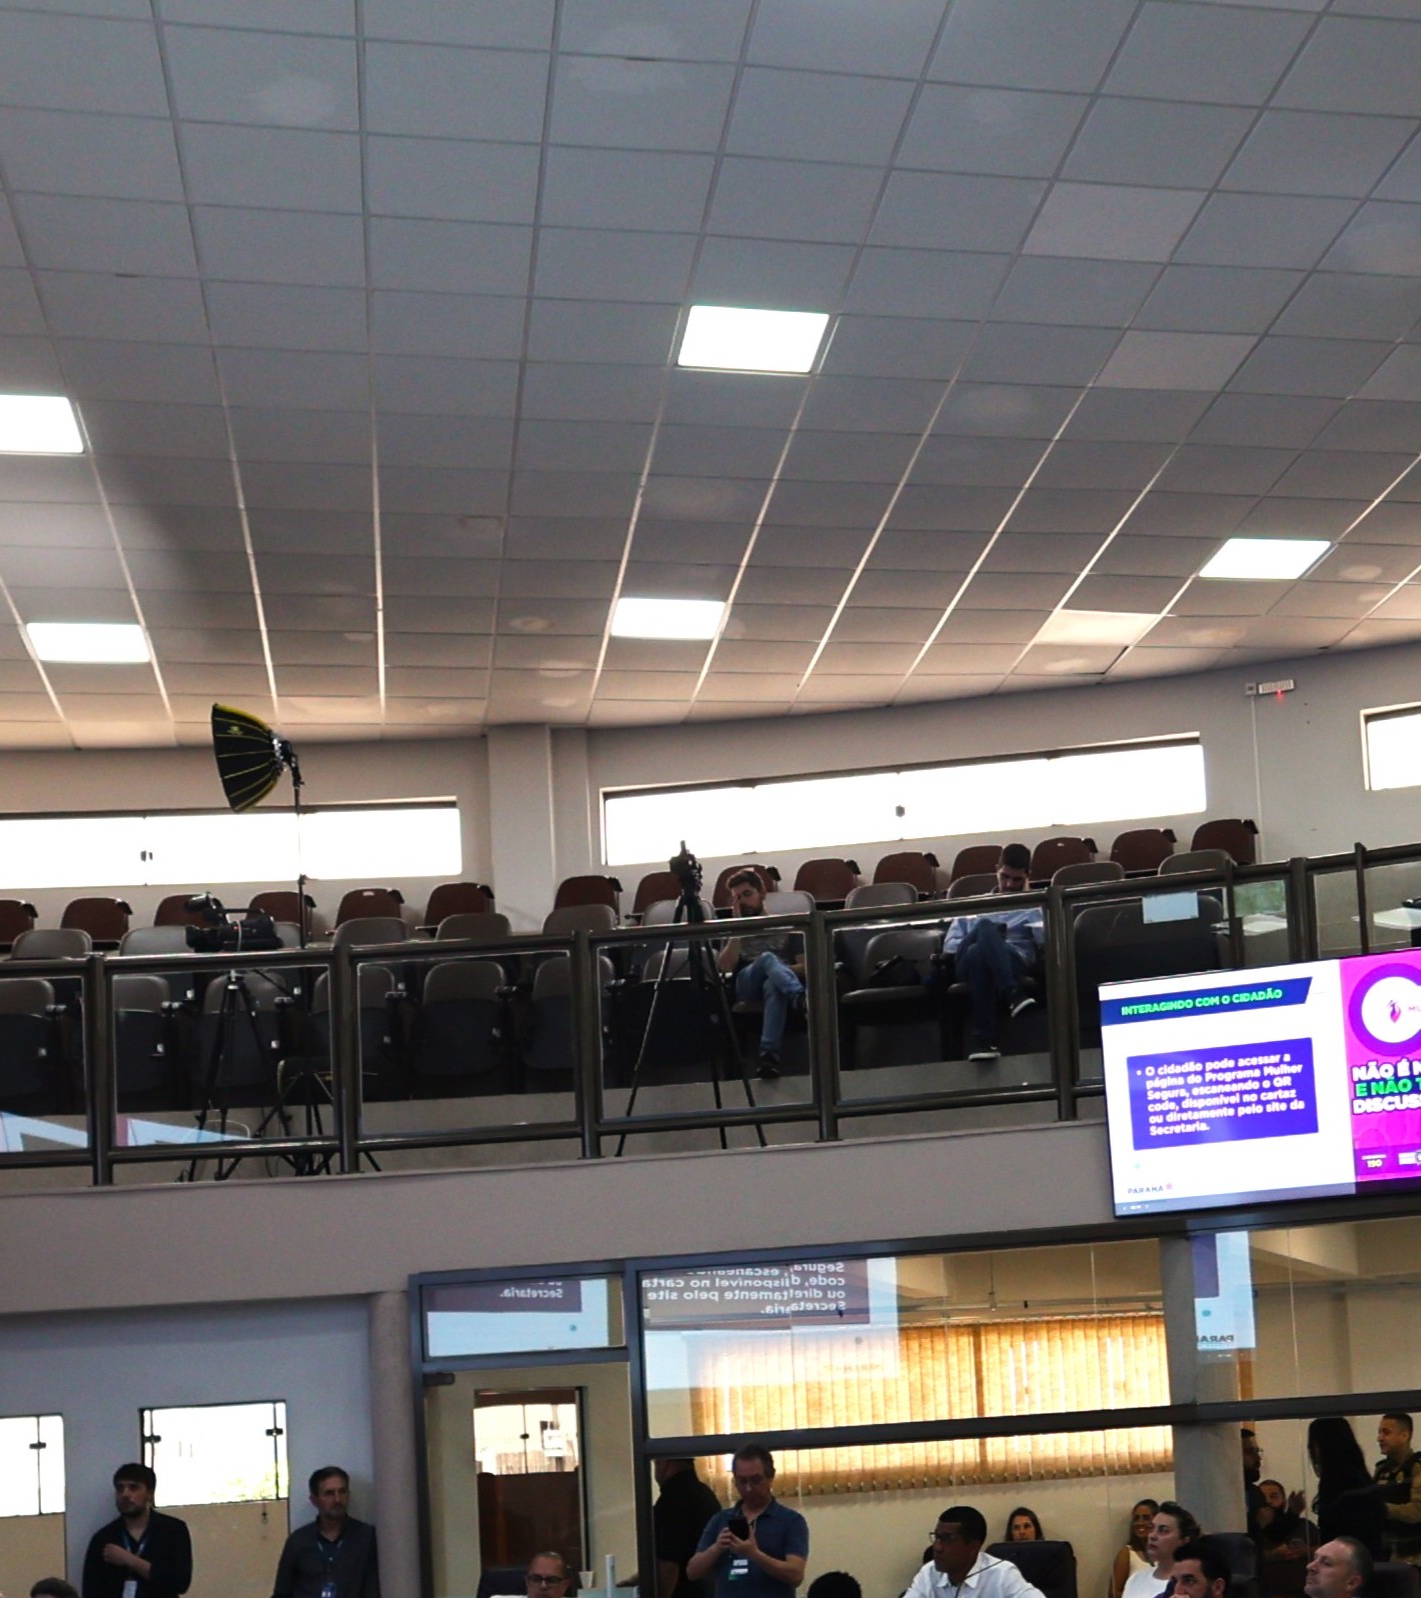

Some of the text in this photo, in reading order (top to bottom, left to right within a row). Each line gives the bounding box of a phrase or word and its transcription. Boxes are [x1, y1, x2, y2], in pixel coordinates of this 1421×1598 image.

[1121, 988, 1282, 1016] INTERAGINDO COM O CIDADÃO
[1145, 1053, 1291, 1076] O cidadão pode acessar a
[1146, 1063, 1303, 1090] página do Programa Mulher
[1352, 1061, 1394, 1081] NÃO
[1397, 1057, 1410, 1077] É
[1147, 1076, 1292, 1102] Segura, escaneando o QR
[1356, 1083, 1367, 1096] E
[1371, 1077, 1412, 1096] NÃO
[1147, 1089, 1297, 1113] code, disponível no cartaz
[1149, 1100, 1305, 1124] ou diretamente pelo site da
[1149, 1122, 1210, 1136] Secretaria.
